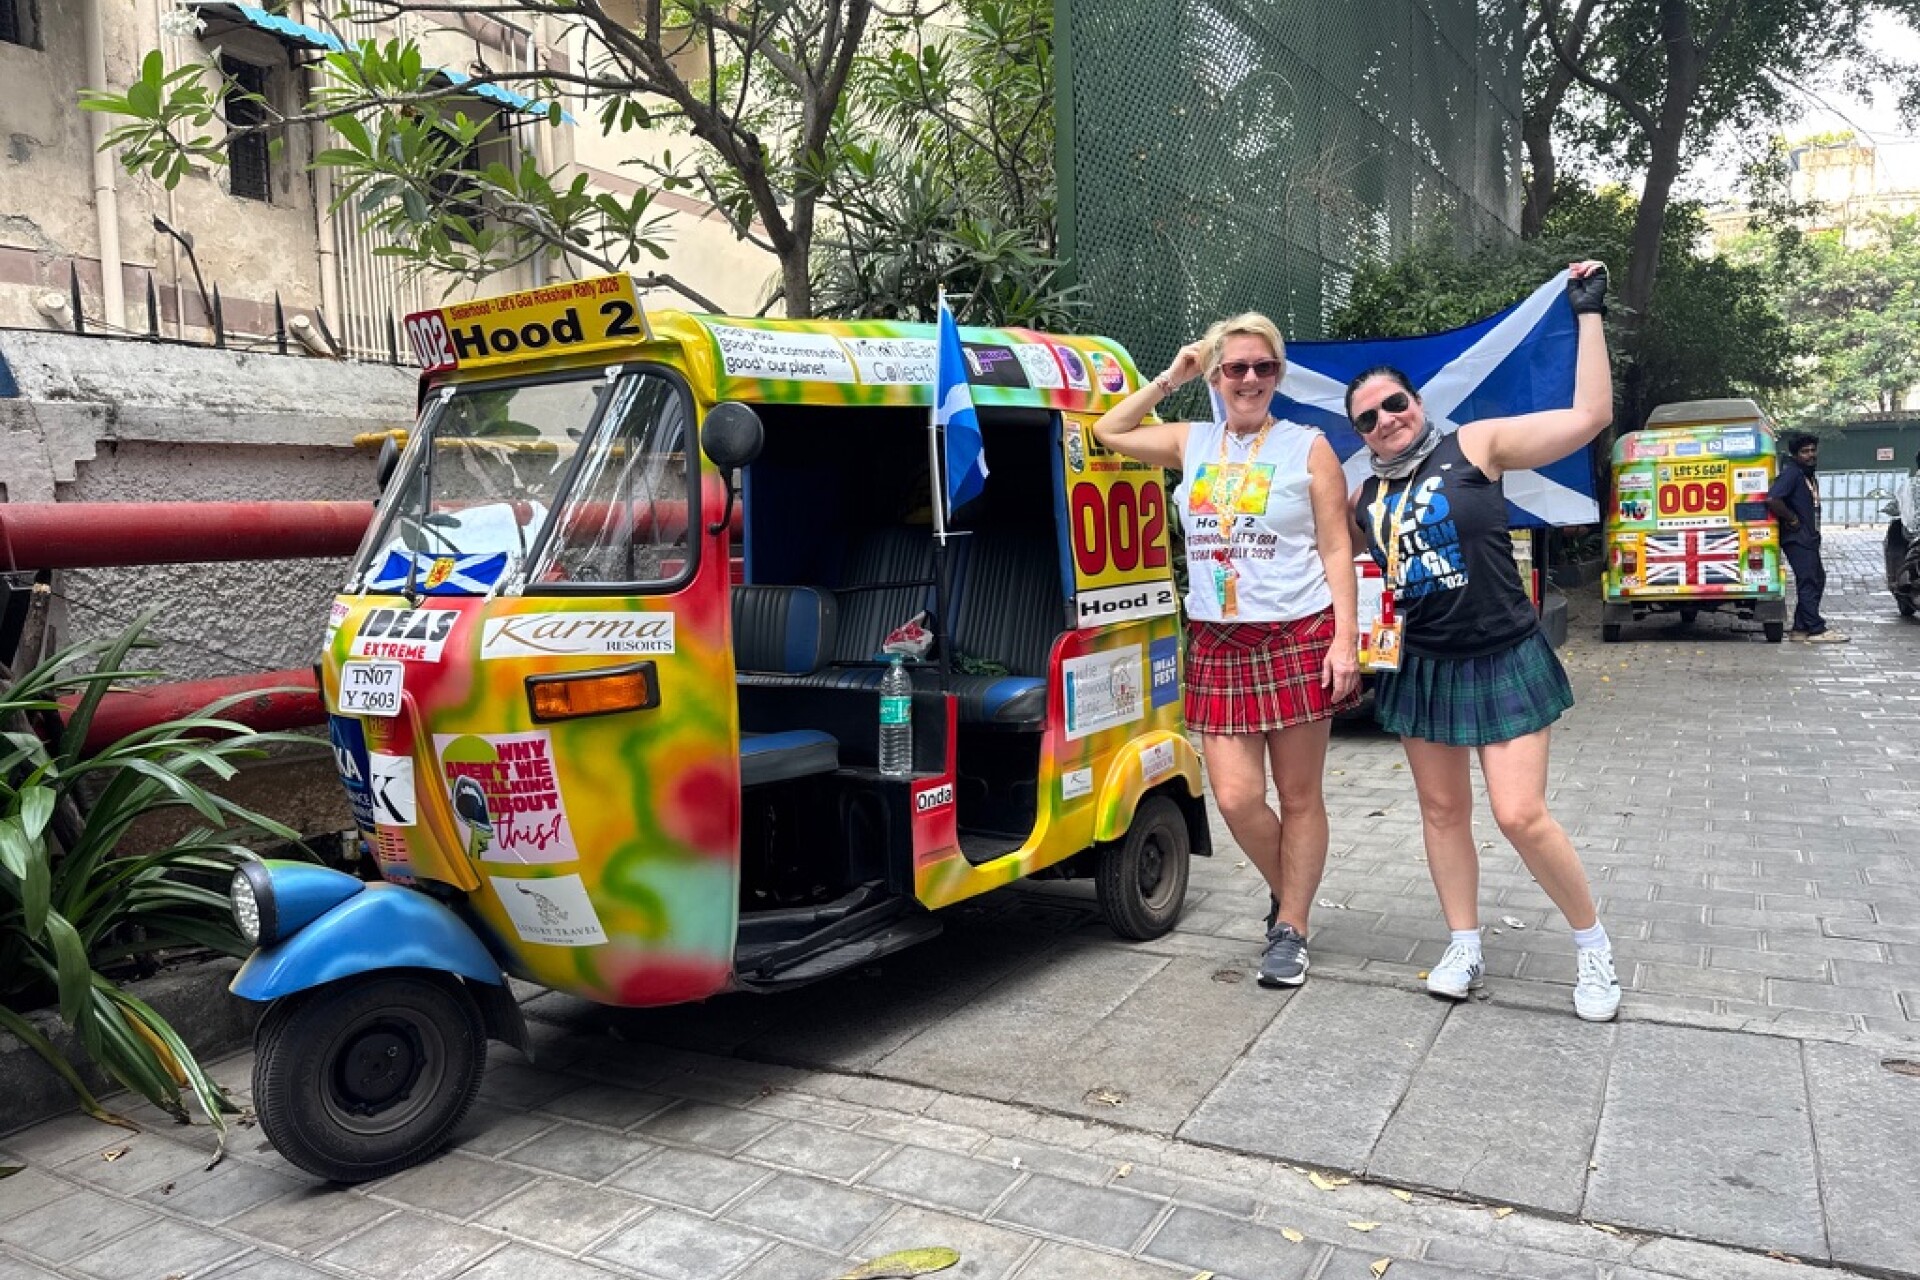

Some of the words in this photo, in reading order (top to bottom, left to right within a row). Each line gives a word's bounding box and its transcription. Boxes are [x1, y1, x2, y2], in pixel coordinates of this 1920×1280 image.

[573, 281, 597, 299] Rally
[451, 307, 585, 359] Hood
[600, 300, 641, 338] 2
[408, 314, 456, 369] 002
[767, 359, 787, 373] our
[1659, 481, 1728, 515] 009
[1072, 480, 1167, 576] 002
[1244, 516, 1256, 528] 2
[1080, 592, 1149, 617] Hood
[1156, 590, 1172, 605] 2
[357, 609, 460, 641] IDEAS
[486, 615, 672, 653] Karma
[363, 641, 427, 660] EXTREME
[606, 639, 673, 652] RESORTS
[352, 669, 393, 686] TN07
[1154, 669, 1177, 688] FEST
[345, 689, 359, 707] Y
[360, 691, 396, 709] 7603
[496, 738, 546, 760] WHY
[514, 757, 551, 779] WE
[481, 776, 555, 794] TALKING
[487, 792, 558, 813] ABOUT
[917, 787, 952, 810] Onda
